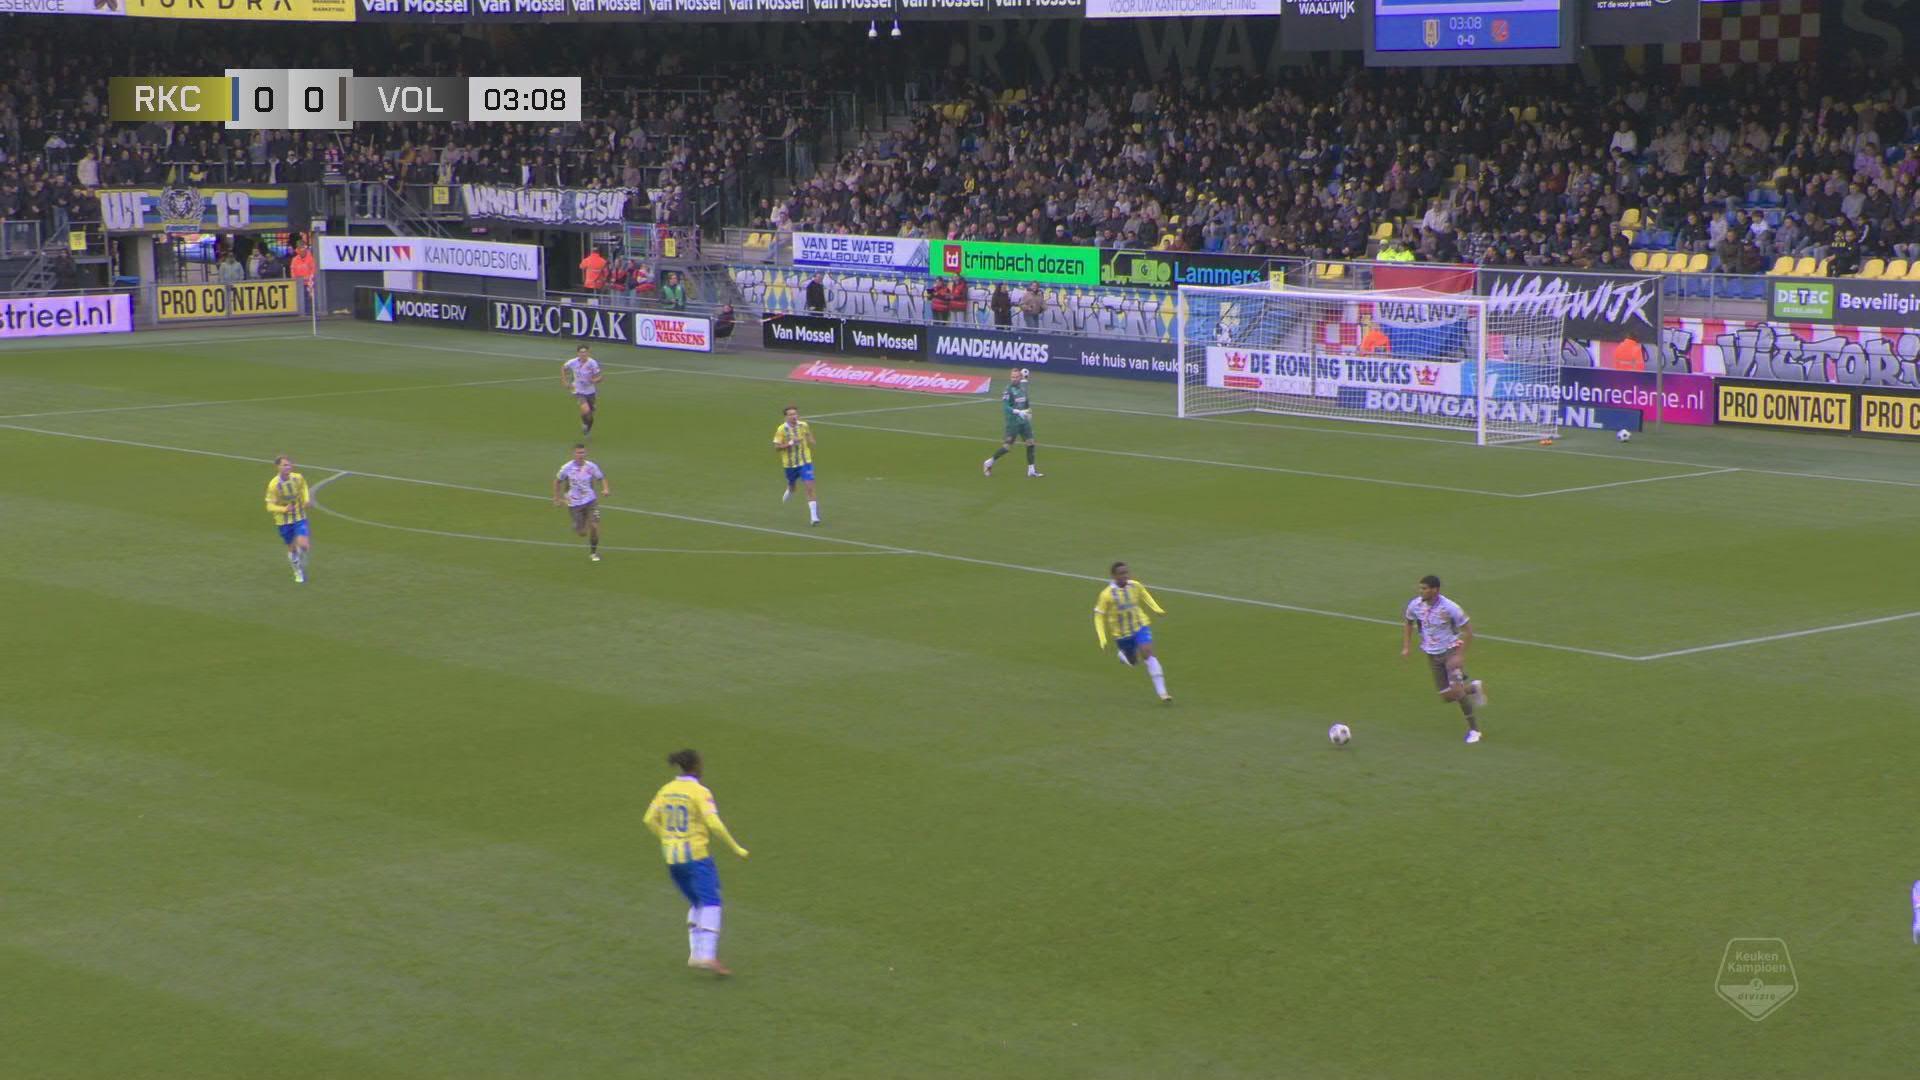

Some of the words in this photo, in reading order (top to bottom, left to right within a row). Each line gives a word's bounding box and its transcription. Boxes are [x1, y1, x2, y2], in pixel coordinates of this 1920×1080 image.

[364, 0, 398, 11] Van
[405, 0, 468, 12] Mossel
[479, 0, 510, 12] Van
[515, 0, 564, 12] Mossel
[573, 0, 594, 11] Van
[597, 0, 641, 11] Mossel
[650, 0, 672, 11] Van
[675, 0, 721, 11] Mossel
[729, 0, 752, 10] Van
[756, 0, 804, 10] Mossel
[1299, 1, 1355, 19] WAALWIJK
[1449, 17, 1482, 30] 03:08
[1457, 34, 1475, 46] 0-0
[102, 191, 150, 230] WF
[212, 191, 250, 229] 19
[336, 245, 390, 262] WINI
[802, 237, 827, 250] VAN
[832, 239, 847, 251] DE
[851, 240, 894, 254] WATER
[802, 250, 869, 263] STAALBOUW
[873, 254, 894, 265] B.V.
[964, 251, 1034, 273] trimbach
[1037, 254, 1084, 275] dozen
[1173, 261, 1261, 284] Lammers
[161, 288, 196, 315] PRO
[201, 284, 290, 313] CONTACT
[1776, 288, 1830, 305] DETEC
[396, 300, 439, 319] MOORE
[441, 304, 467, 321] DRV
[494, 301, 628, 340] EDEC-DAK
[654, 319, 684, 332] WILLY
[772, 324, 793, 341] Van
[796, 326, 834, 344] Mossel
[656, 331, 705, 346] NAESSENS
[853, 330, 875, 348] Van
[878, 333, 918, 351] Mossel
[936, 336, 1049, 363] MANDEMAKERS
[1082, 351, 1101, 367] hét
[1104, 353, 1128, 369] huis
[1130, 359, 1149, 371] van
[1152, 357, 1200, 375] keukns
[1250, 353, 1270, 374] DE
[1275, 355, 1341, 380] KONNG
[1346, 358, 1411, 386] TRUCKS
[805, 361, 874, 382] Keuken
[873, 368, 970, 391] Kampioen
[1723, 392, 1758, 419] PRO
[1763, 393, 1847, 424] CONTACT
[1866, 400, 1903, 429] PRO
[665, 804, 689, 833] 20
